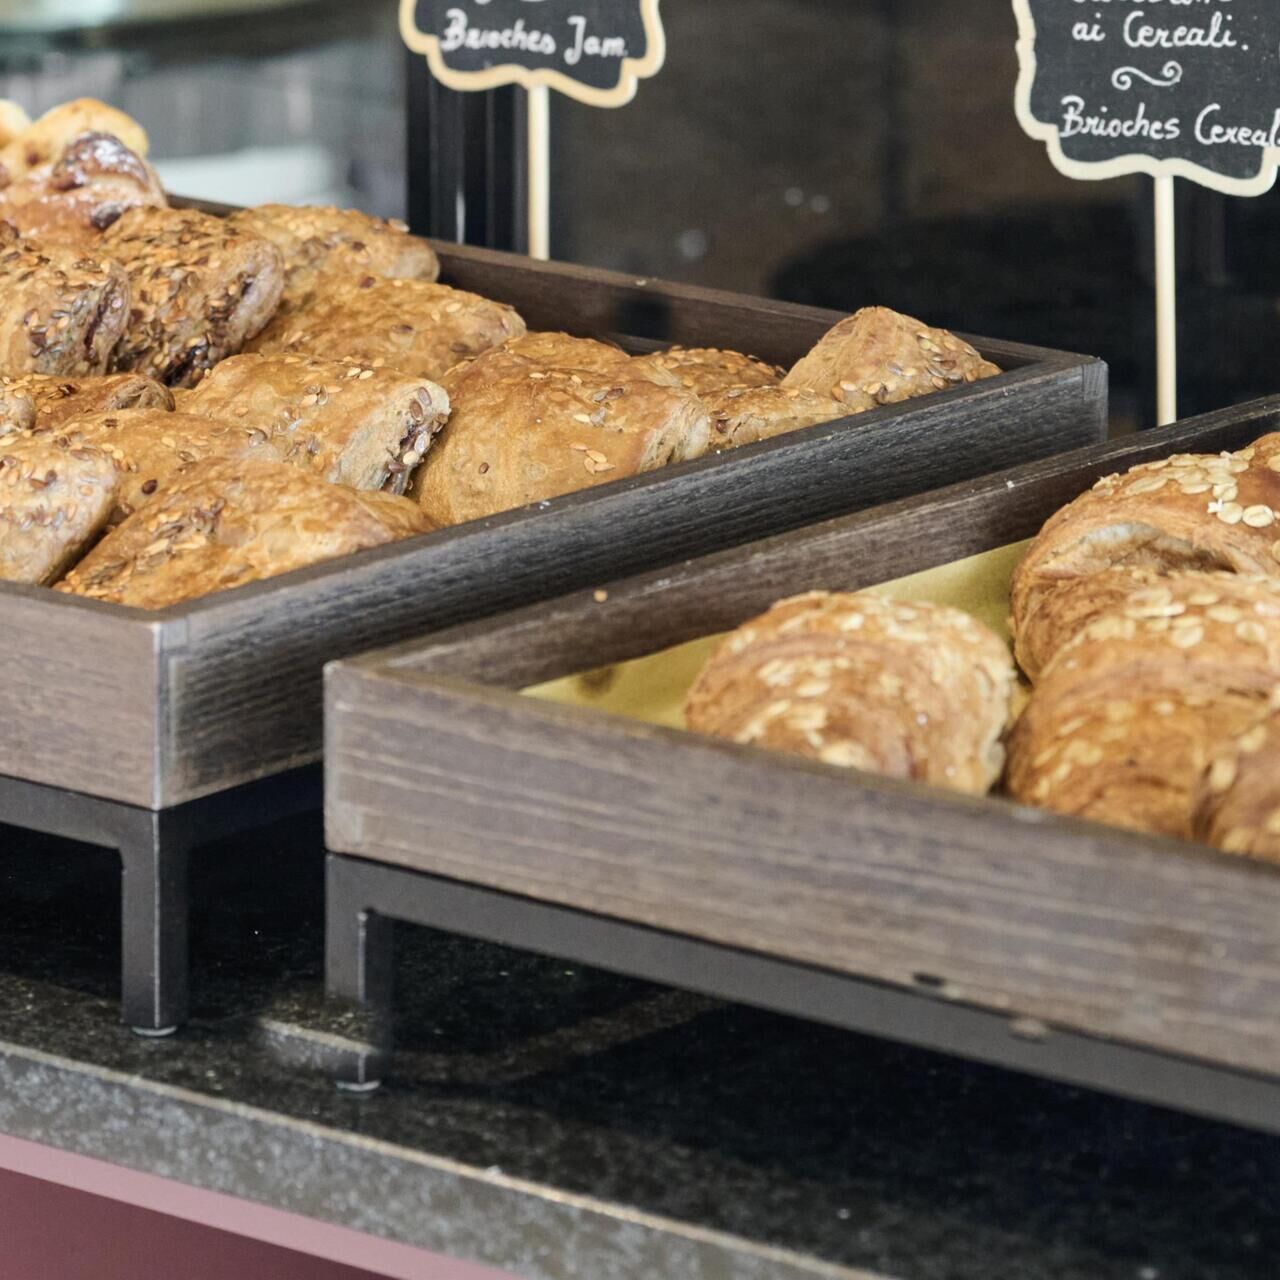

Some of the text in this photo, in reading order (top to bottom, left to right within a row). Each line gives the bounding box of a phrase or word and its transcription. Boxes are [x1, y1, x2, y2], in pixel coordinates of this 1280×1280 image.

[1072, 11, 1249, 51] ai Cereali.
[1059, 95, 1180, 139] Brioches
